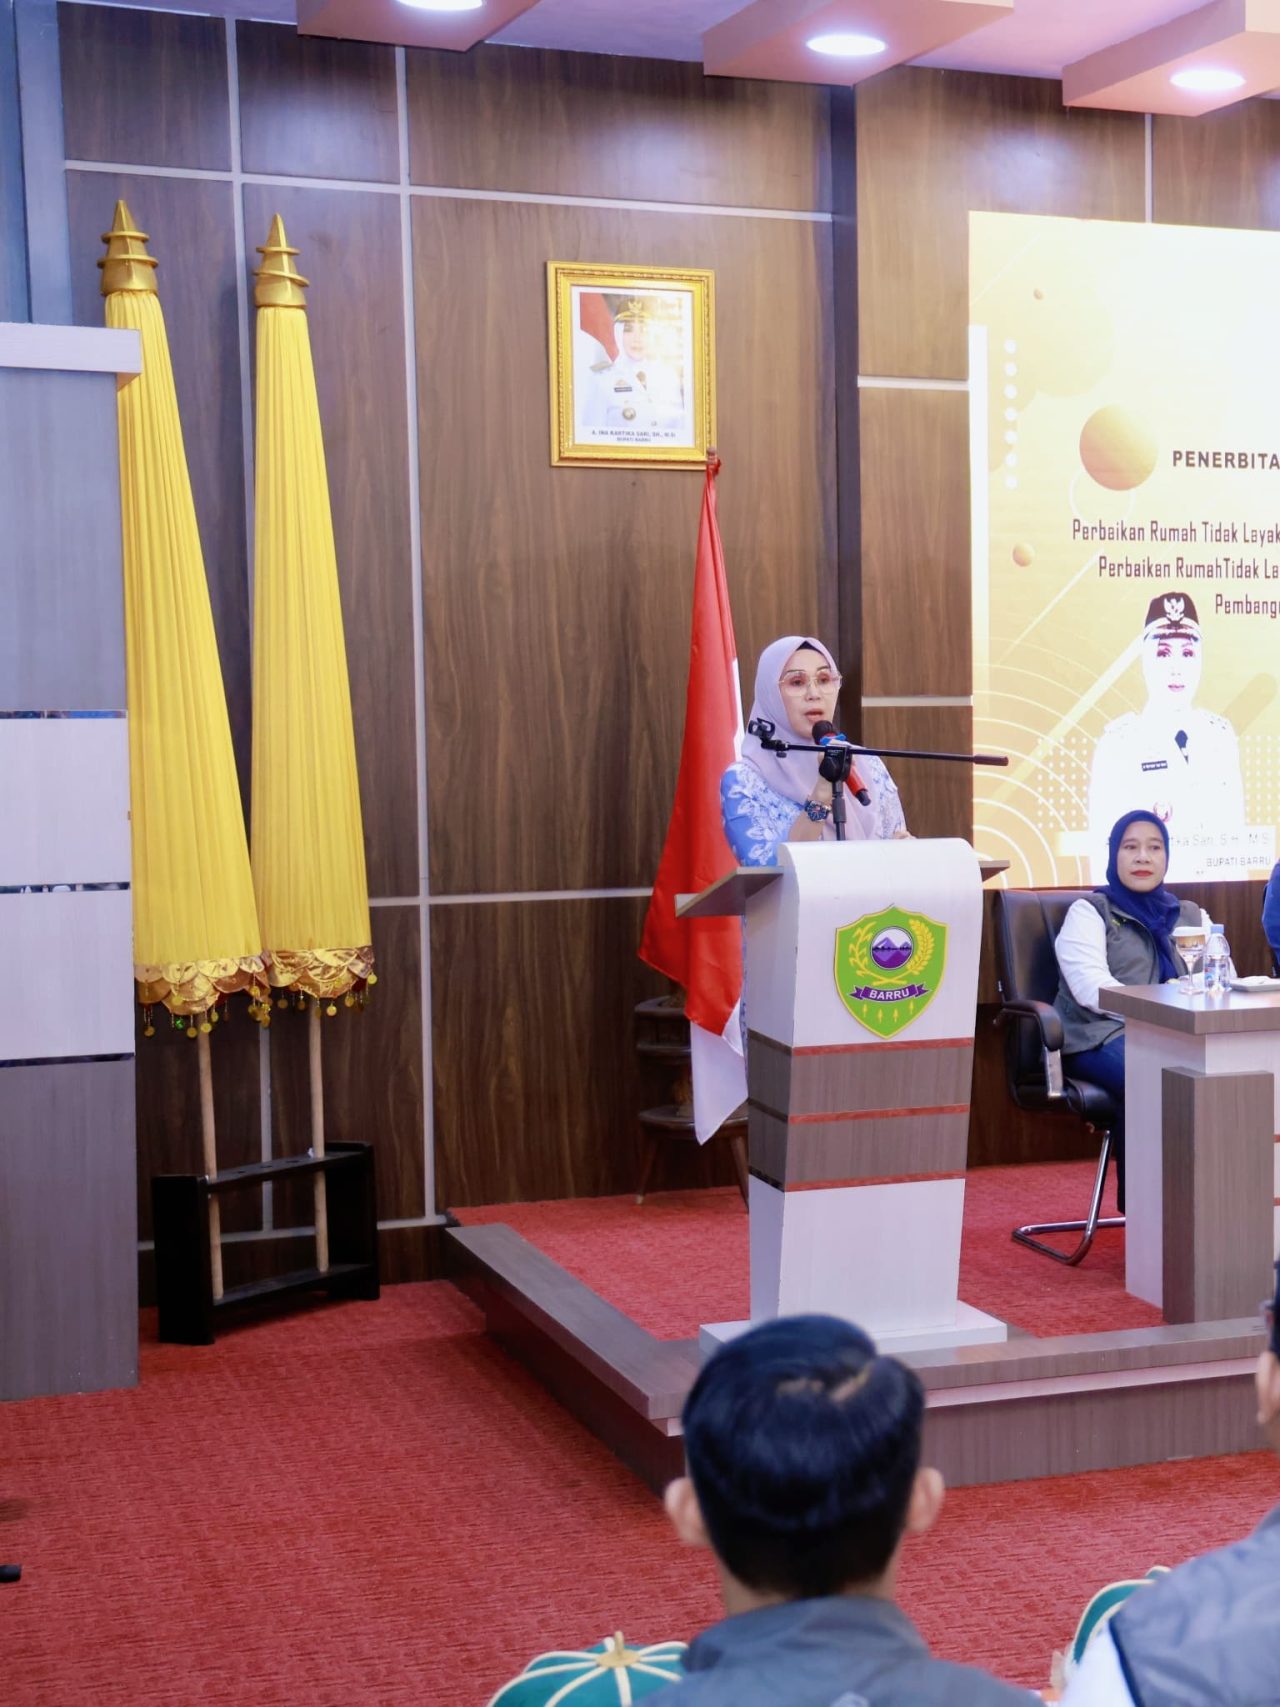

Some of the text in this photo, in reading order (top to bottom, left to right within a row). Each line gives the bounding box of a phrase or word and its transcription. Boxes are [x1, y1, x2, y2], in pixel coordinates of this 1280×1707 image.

[1072, 518, 1145, 542] Perbaikan
[1150, 519, 1197, 543] Rumah
[1201, 520, 1239, 544] Tidak
[1098, 555, 1171, 578] Perbaikan
[869, 988, 910, 1000] BARRU
